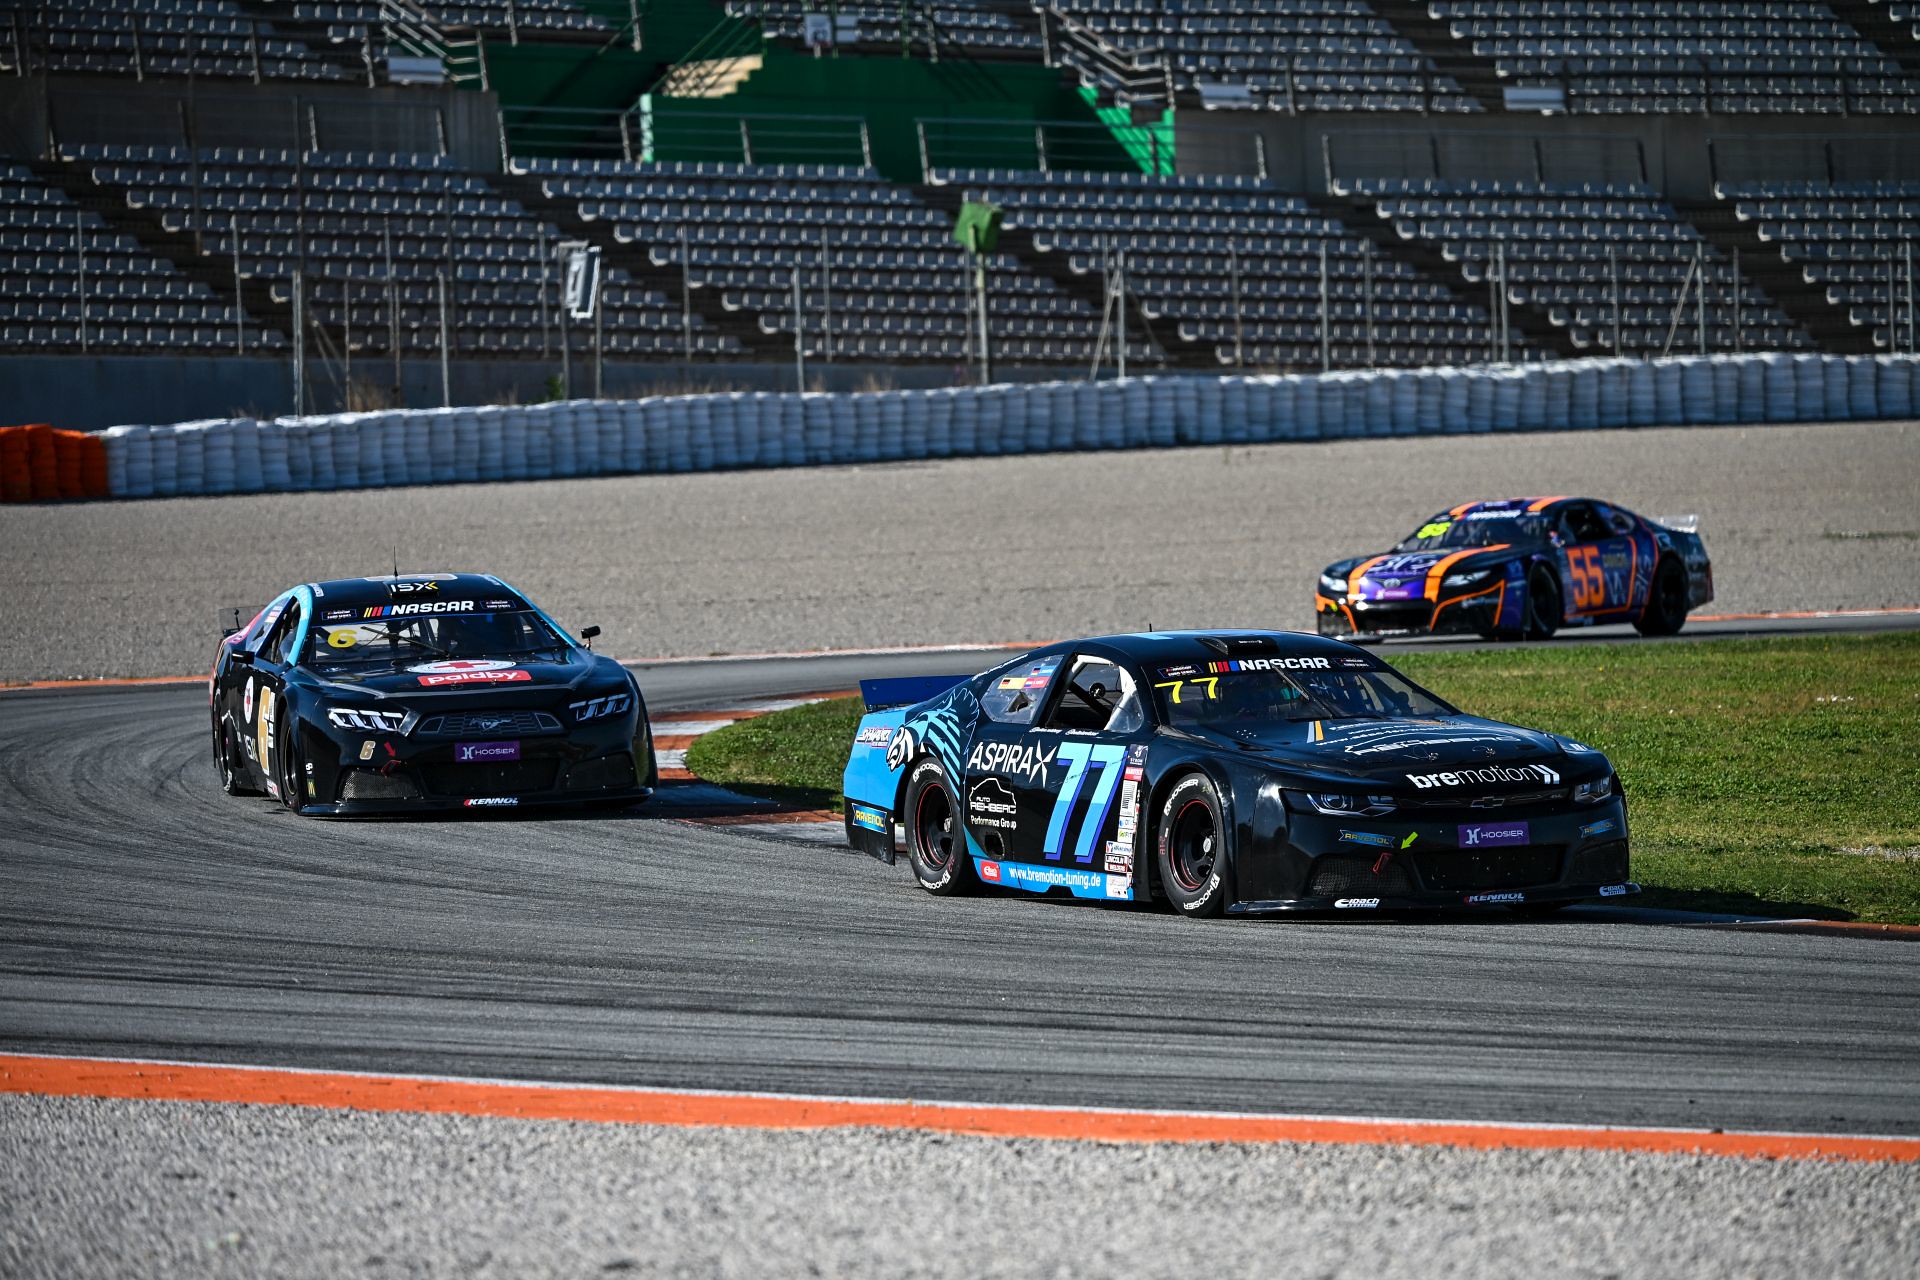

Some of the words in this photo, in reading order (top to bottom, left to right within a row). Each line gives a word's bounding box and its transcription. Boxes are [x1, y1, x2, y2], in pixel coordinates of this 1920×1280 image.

[1566, 545, 1606, 609] 55
[390, 600, 475, 616] NASCAR
[327, 629, 358, 648] 6
[1238, 657, 1332, 671] NASCAR
[1154, 676, 1219, 704] 77
[359, 740, 376, 760] 6
[1405, 765, 1540, 789] bremotion
[468, 797, 518, 806] KENNOL
[1042, 741, 1129, 864] 77
[1009, 867, 1101, 890] www.bremotion-tuning.de
[1468, 892, 1525, 903] KENNOL
